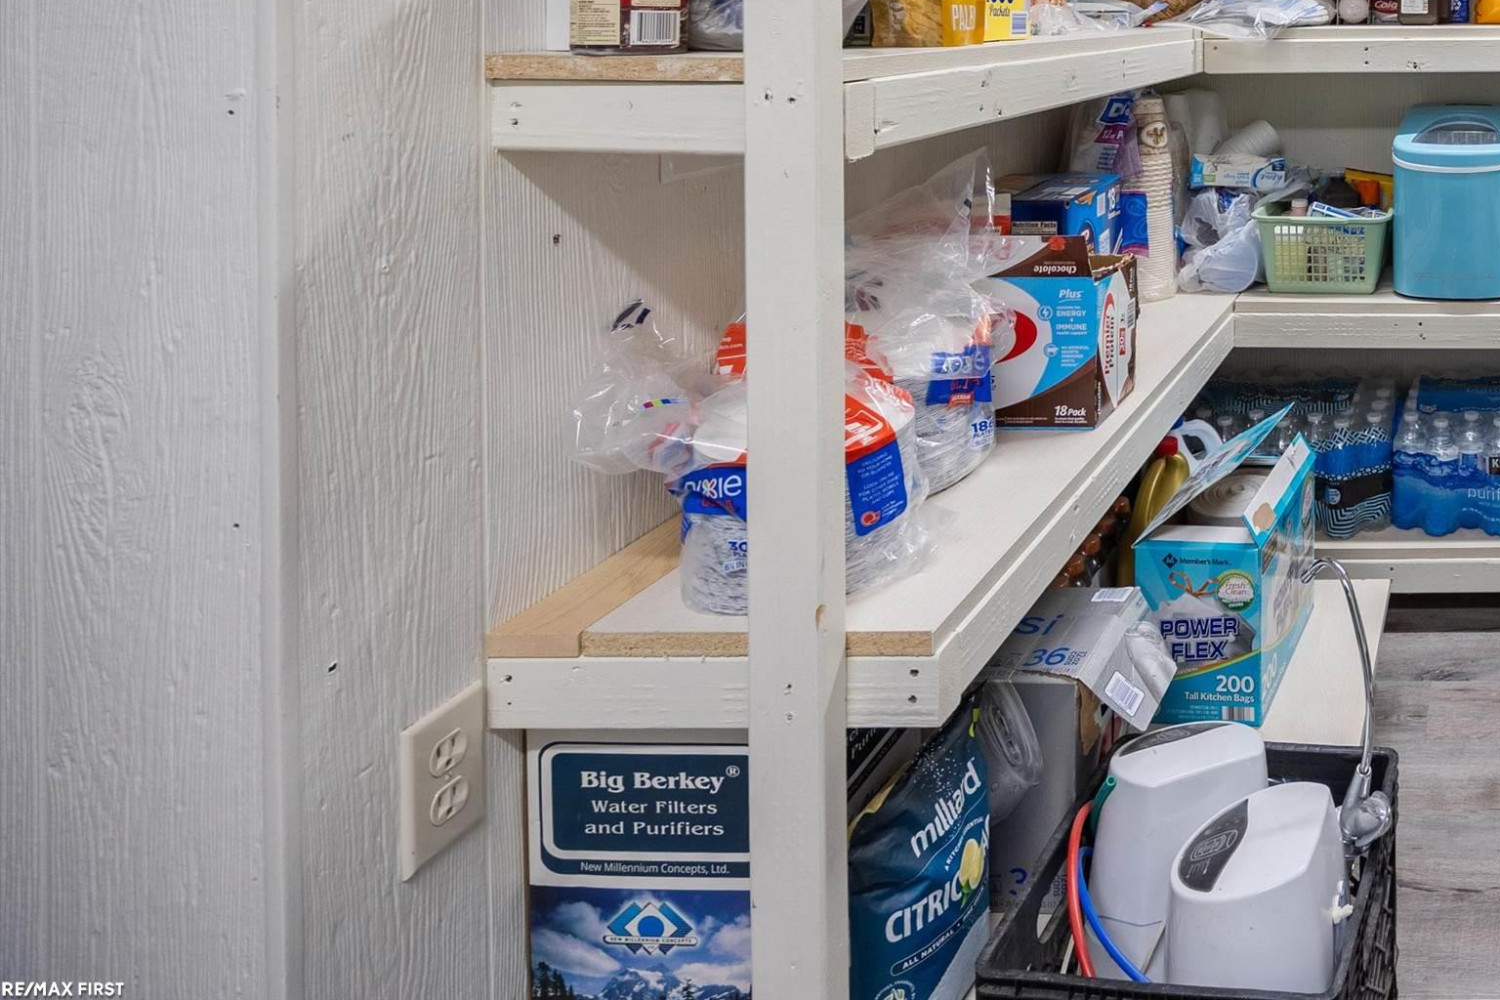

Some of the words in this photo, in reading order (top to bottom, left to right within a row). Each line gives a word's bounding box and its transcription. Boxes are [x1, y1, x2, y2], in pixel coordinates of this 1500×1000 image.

[1058, 288, 1083, 299] Plus
[1056, 309, 1087, 317] ENERGY
[1055, 323, 1088, 331] IMMUNE
[1053, 404, 1067, 417] 18
[1067, 406, 1087, 417] Pack
[1178, 557, 1210, 566] Member's
[1160, 617, 1240, 637] POWER
[1024, 646, 1070, 667] 36
[1172, 641, 1227, 661] FLEX
[1215, 674, 1255, 693] 200
[1184, 691, 1199, 701] Tall
[1200, 692, 1232, 702] Kitchen
[1233, 693, 1255, 704] Bags
[580, 771, 625, 793] Big
[590, 799, 649, 815] Water
[655, 800, 719, 815] Filters
[910, 757, 982, 858] milliard
[584, 821, 625, 835] and
[632, 821, 726, 836] Purifiers
[580, 861, 602, 873] New
[603, 861, 659, 874] Millennium
[660, 862, 709, 876] Concepts,
[711, 863, 731, 875] Ltd.
[884, 870, 963, 944] CITRIC
[901, 955, 921, 970] ALL
[920, 929, 956, 961] NATURAL
